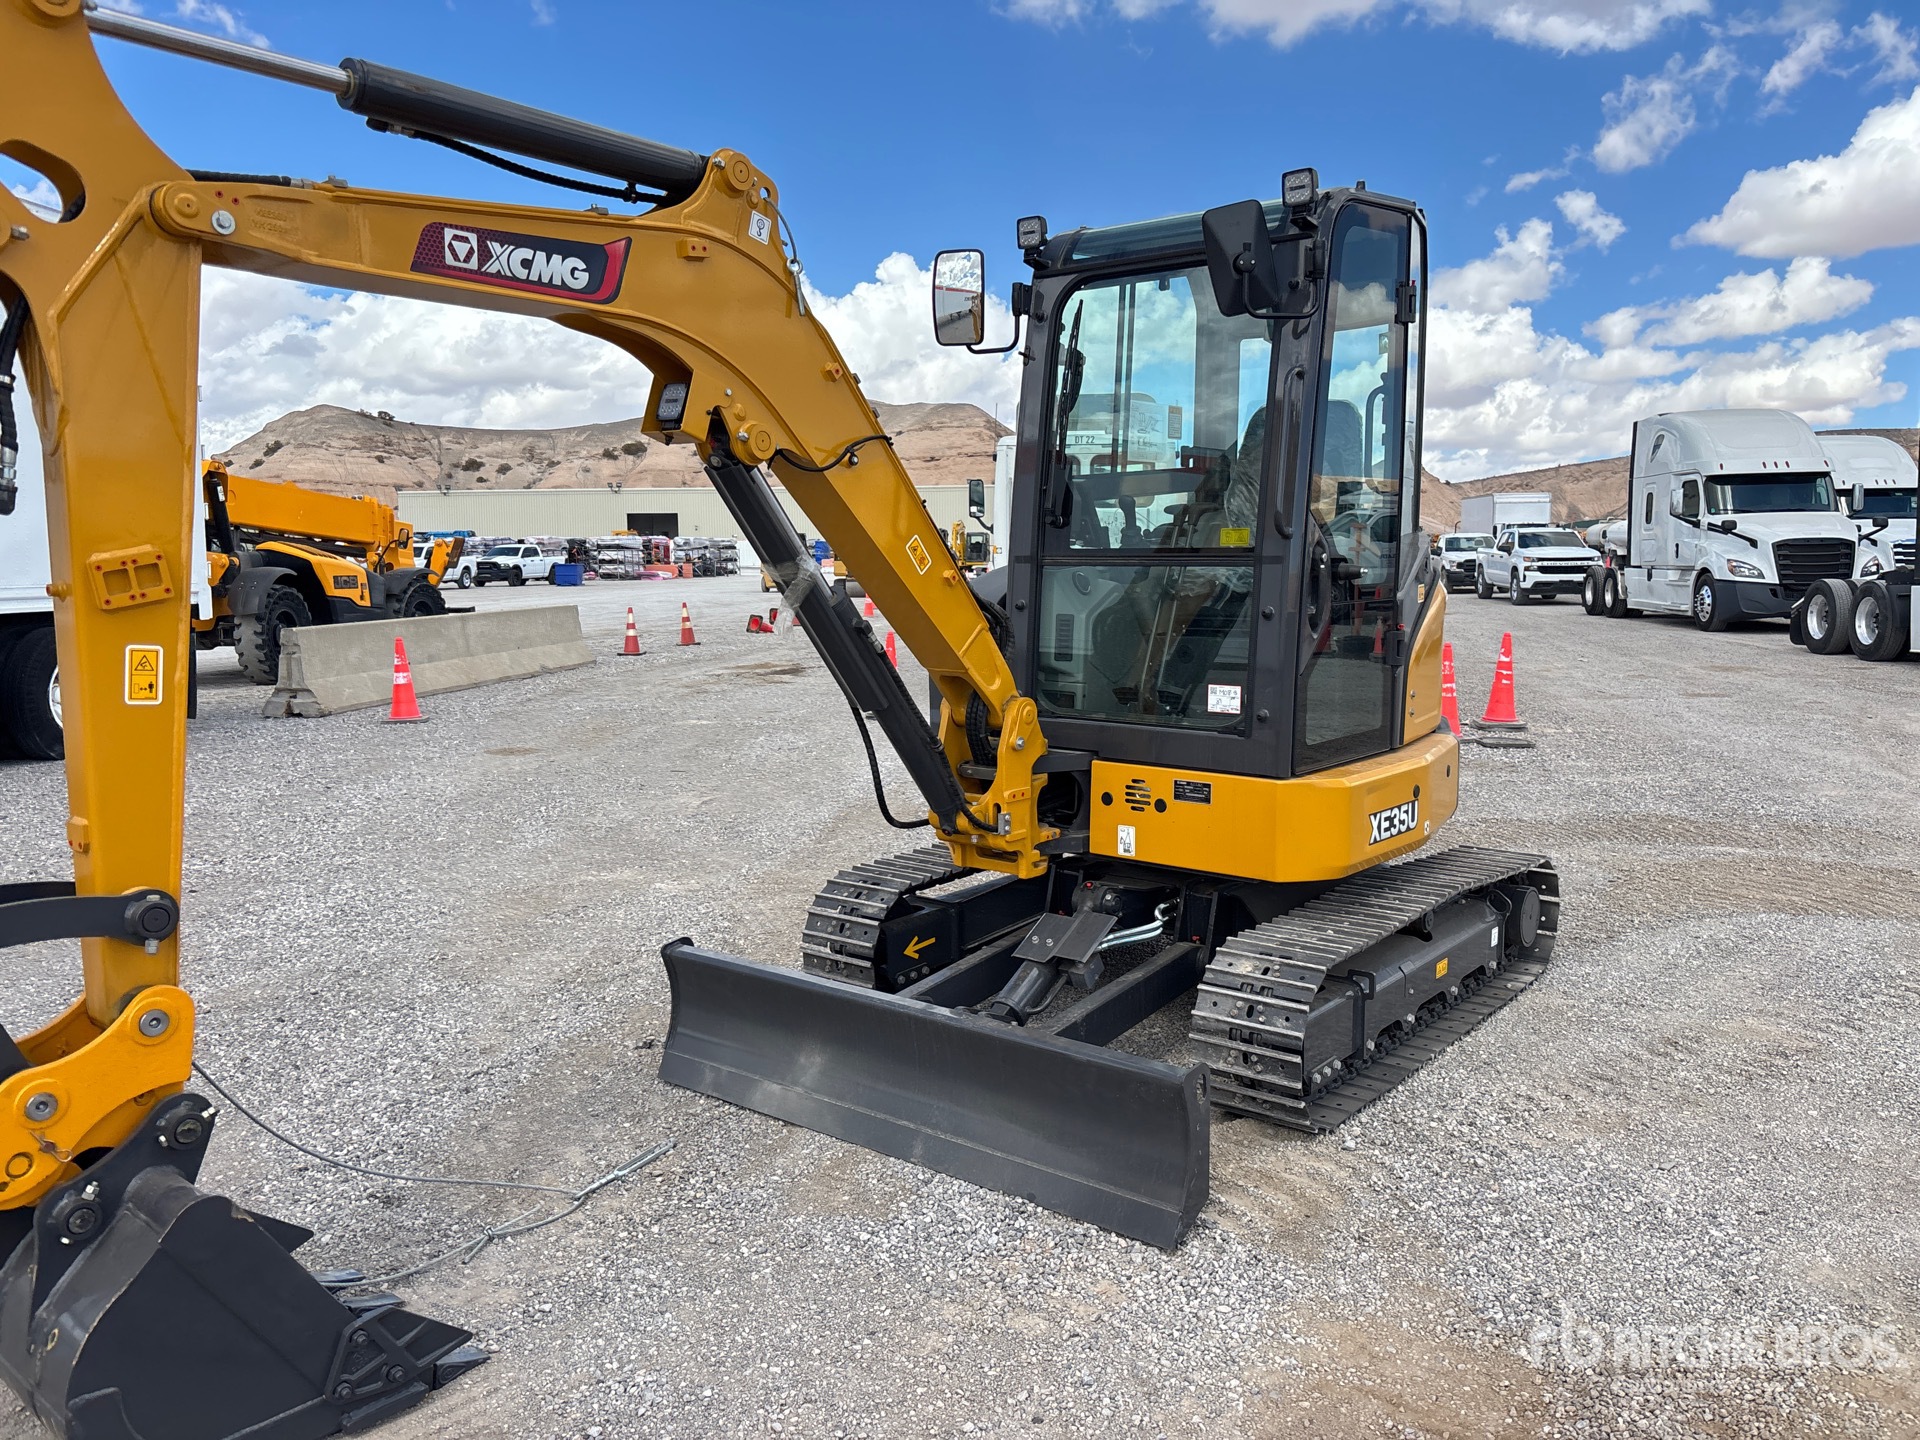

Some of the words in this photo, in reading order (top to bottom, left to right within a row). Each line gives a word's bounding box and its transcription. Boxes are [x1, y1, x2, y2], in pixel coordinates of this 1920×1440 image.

[481, 240, 589, 290] XCMG
[333, 575, 358, 589] JCB
[1369, 800, 1418, 844] XE35U
